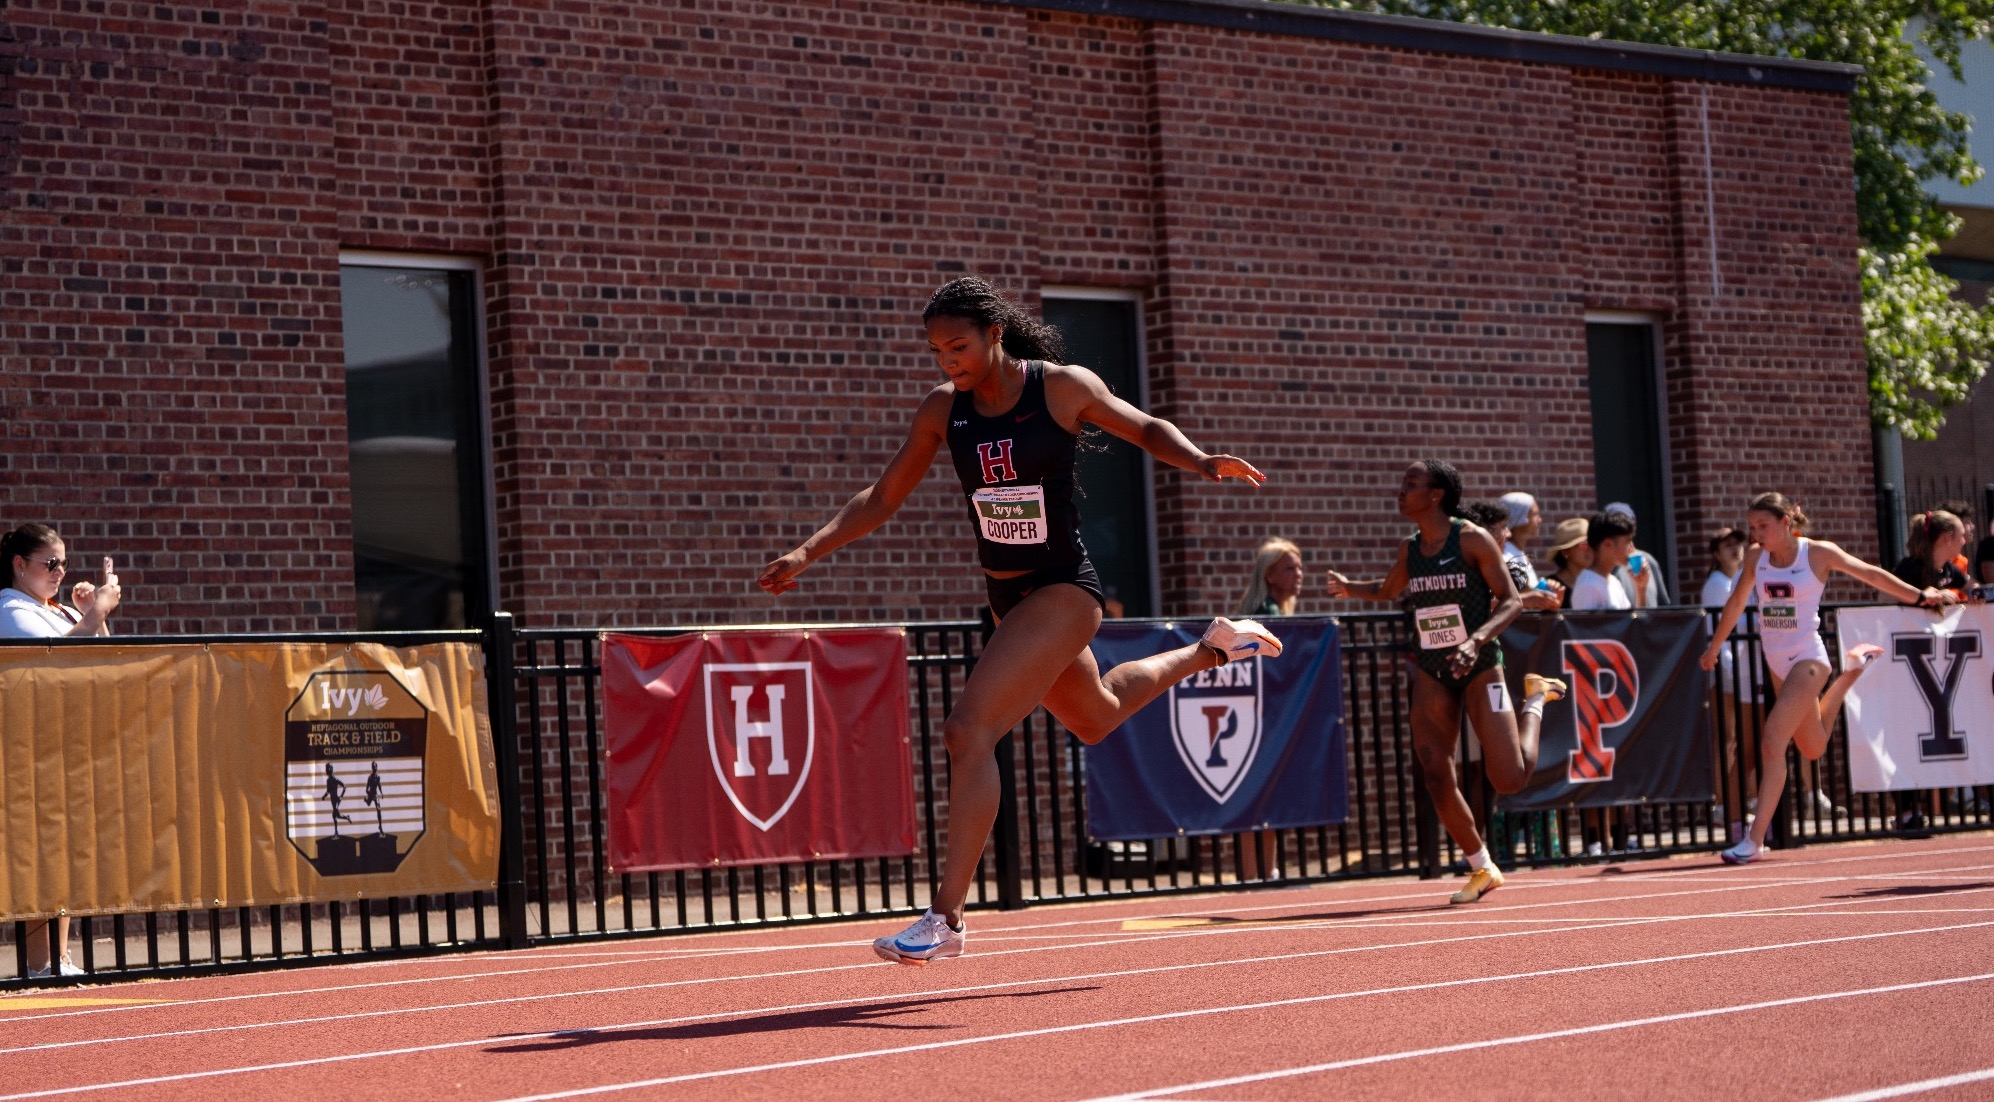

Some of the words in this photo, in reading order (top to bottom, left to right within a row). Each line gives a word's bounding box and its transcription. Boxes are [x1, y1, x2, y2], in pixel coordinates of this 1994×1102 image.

[977, 439, 1017, 484] H
[992, 504, 1012, 517] Ivy
[987, 520, 1037, 539] COOPER
[1429, 620, 1442, 628] Ivy
[1764, 619, 1797, 628] ANDERSON
[1429, 630, 1456, 644] JONES
[320, 681, 362, 716] Ivy
[1493, 685, 1503, 709] 7
[1892, 630, 1982, 762] Y
[1561, 639, 1639, 783] P
[312, 723, 358, 732] HEPTAGONAL
[360, 722, 395, 730] OUTDOOR
[731, 684, 789, 777] H
[307, 732, 349, 746] TRACK
[352, 731, 360, 743] &
[364, 730, 401, 743] FIELD
[1202, 706, 1238, 768] P
[323, 746, 383, 755] CHAMPIONSHIPS
